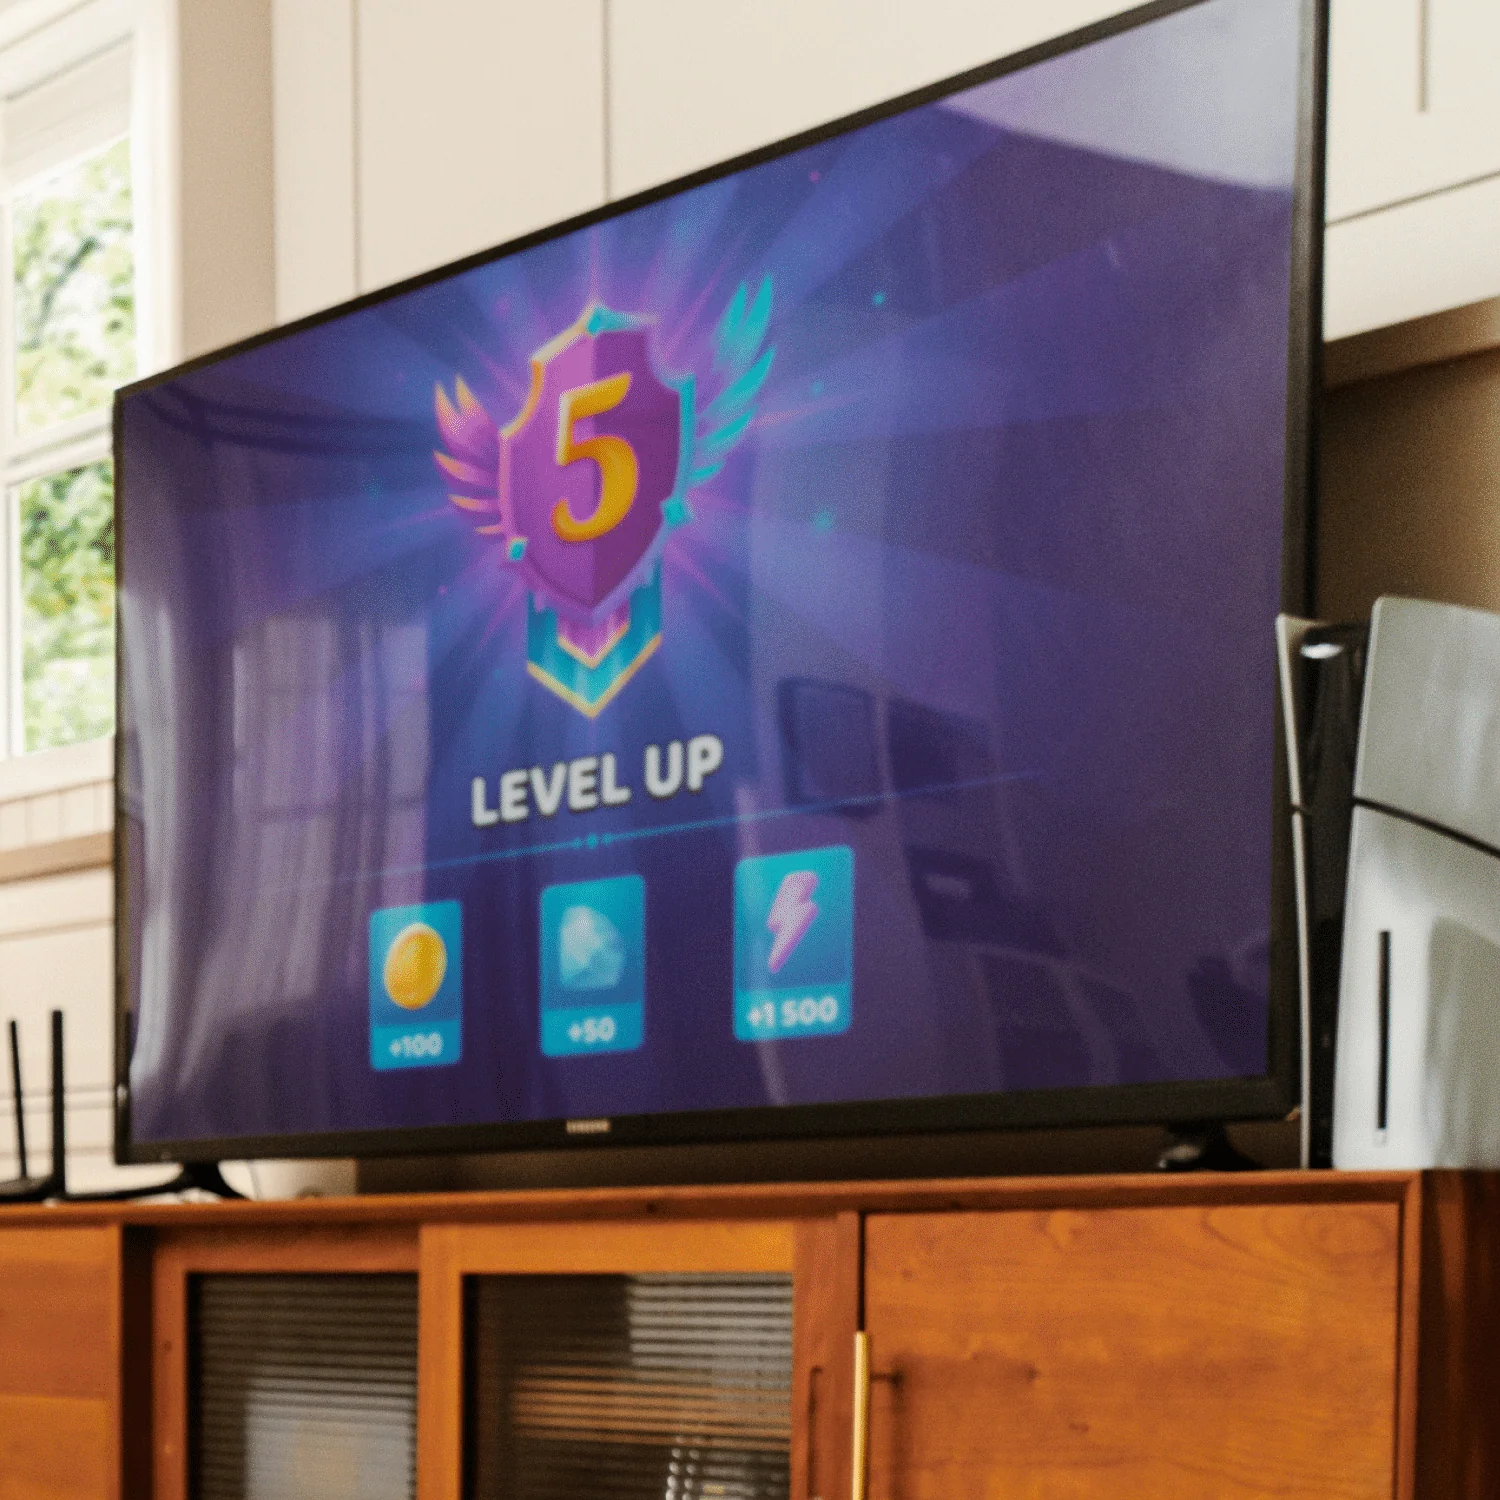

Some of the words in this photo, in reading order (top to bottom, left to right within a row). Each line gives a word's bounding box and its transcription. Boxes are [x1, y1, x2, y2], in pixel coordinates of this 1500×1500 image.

[551, 371, 640, 543] 5
[470, 753, 631, 827] LEVEL
[644, 735, 724, 797] UP
[389, 1033, 443, 1057] +100
[568, 1018, 616, 1045] +50
